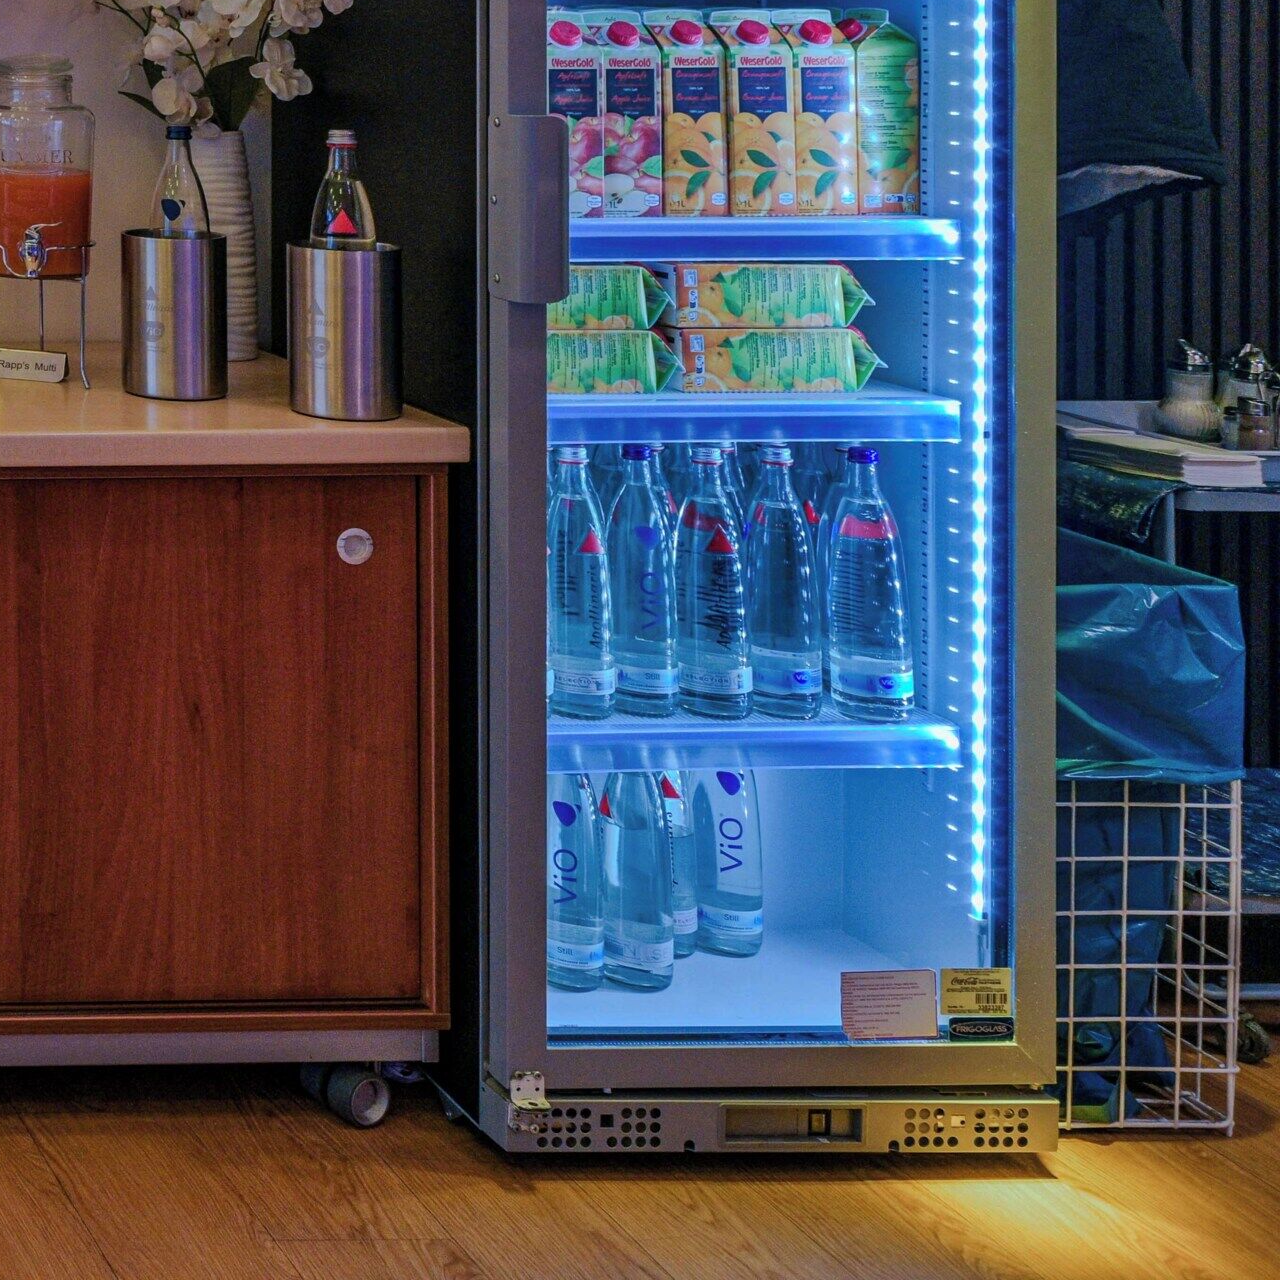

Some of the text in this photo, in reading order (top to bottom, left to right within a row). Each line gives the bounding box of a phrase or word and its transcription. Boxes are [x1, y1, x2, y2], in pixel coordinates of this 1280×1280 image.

[552, 58, 593, 67] WeserGold
[609, 58, 650, 67] WeserGold
[674, 57, 715, 65] WeserGold
[741, 57, 782, 65] WeserGold
[804, 57, 845, 65] WeserGold
[34, 363, 57, 372] Multi
[719, 817, 743, 873] ViO
[553, 848, 578, 904] ViO
[724, 913, 739, 921] Still
[557, 946, 573, 956] Still
